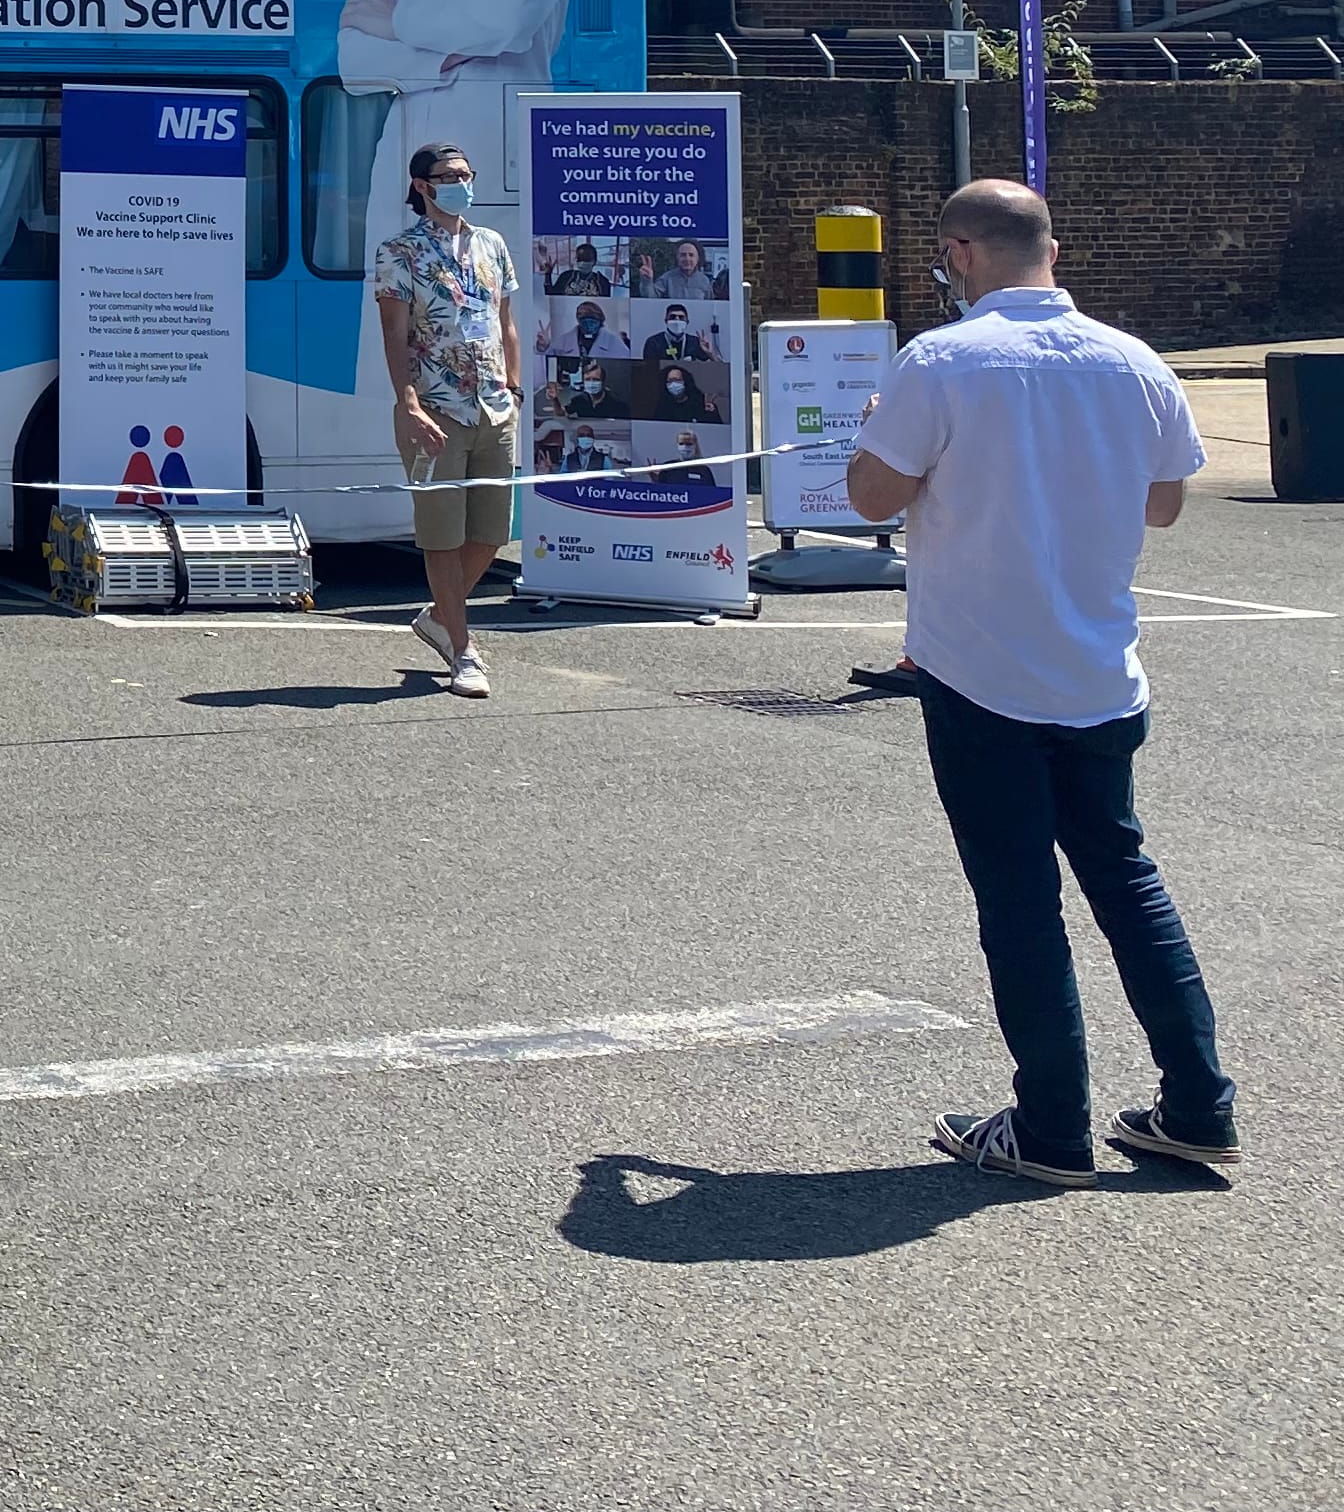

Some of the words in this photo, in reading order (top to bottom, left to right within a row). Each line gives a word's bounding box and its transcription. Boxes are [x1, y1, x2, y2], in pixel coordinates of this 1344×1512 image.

[158, 107, 238, 141] NHS
[576, 121, 608, 135] had
[614, 125, 639, 139] my
[645, 121, 715, 138] vaccine,
[552, 143, 598, 158] make
[603, 147, 640, 158] sure
[645, 147, 677, 162] you
[683, 144, 706, 159] do
[563, 169, 603, 183] your
[608, 166, 631, 181] bit
[635, 166, 660, 181] for
[665, 167, 694, 181] the
[129, 196, 163, 206] COVID
[167, 197, 180, 207] 19
[560, 189, 659, 207] community
[664, 190, 698, 204] and
[96, 211, 136, 223] Vaccine
[139, 212, 183, 224] Support
[186, 213, 216, 224] Clinic
[563, 211, 604, 226] have
[609, 214, 657, 229] yours
[662, 214, 696, 227] too.
[77, 227, 94, 237] We
[96, 229, 113, 237] are
[116, 228, 138, 238] here
[142, 230, 153, 239] to
[157, 229, 179, 241] help
[183, 232, 207, 240] save
[211, 230, 233, 241] lives
[89, 266, 103, 274] The
[105, 266, 134, 275] Vaccine
[144, 267, 164, 276] SAFE
[799, 413, 820, 426] GH
[576, 487, 586, 497] V
[588, 487, 606, 498] for
[610, 487, 688, 503] #Vaccinated
[800, 494, 835, 502] ROYAL
[800, 504, 853, 512] GREENWI
[559, 545, 594, 554] ENFIELD
[615, 546, 651, 560] NHS
[666, 551, 710, 561] ENFIELD
